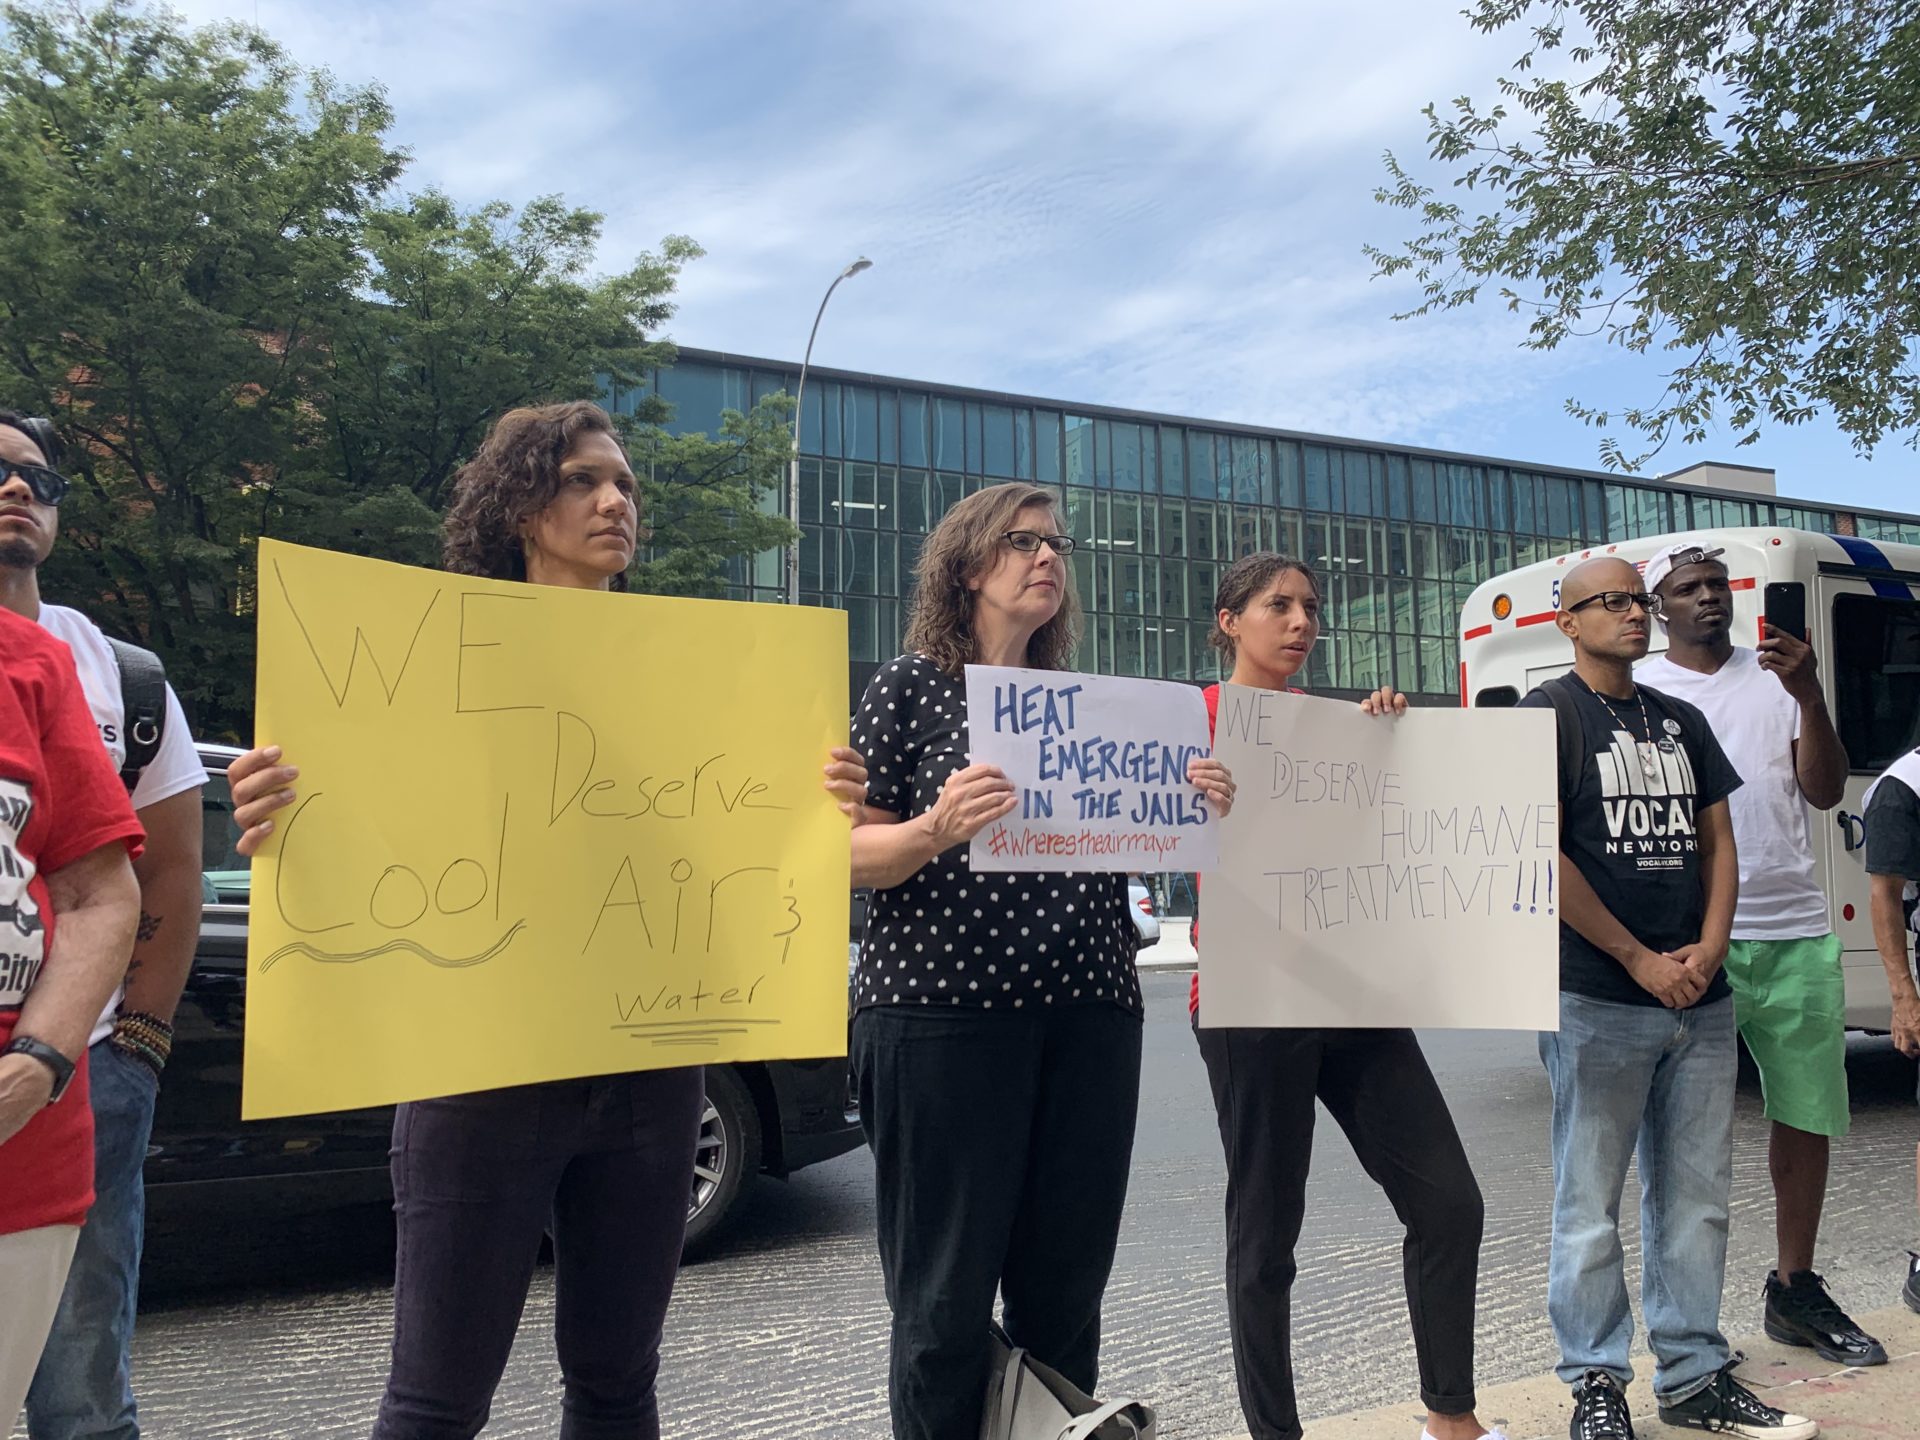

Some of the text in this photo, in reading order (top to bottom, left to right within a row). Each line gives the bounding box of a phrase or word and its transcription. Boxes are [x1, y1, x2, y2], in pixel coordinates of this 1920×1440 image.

[273, 557, 545, 713] WE
[994, 682, 1083, 736] HEAT
[1223, 685, 1275, 746] WE
[548, 711, 793, 828] Deserve
[1270, 751, 1404, 809] DESERVE
[1023, 788, 1209, 826] IN THE JAILS
[1381, 804, 1557, 861] HUMANE
[1602, 798, 1697, 838] VOCAL
[276, 792, 509, 933] Cool
[582, 855, 779, 954] Air
[1606, 840, 1654, 854] NEW
[1263, 859, 1555, 931] TREATMENT!!!
